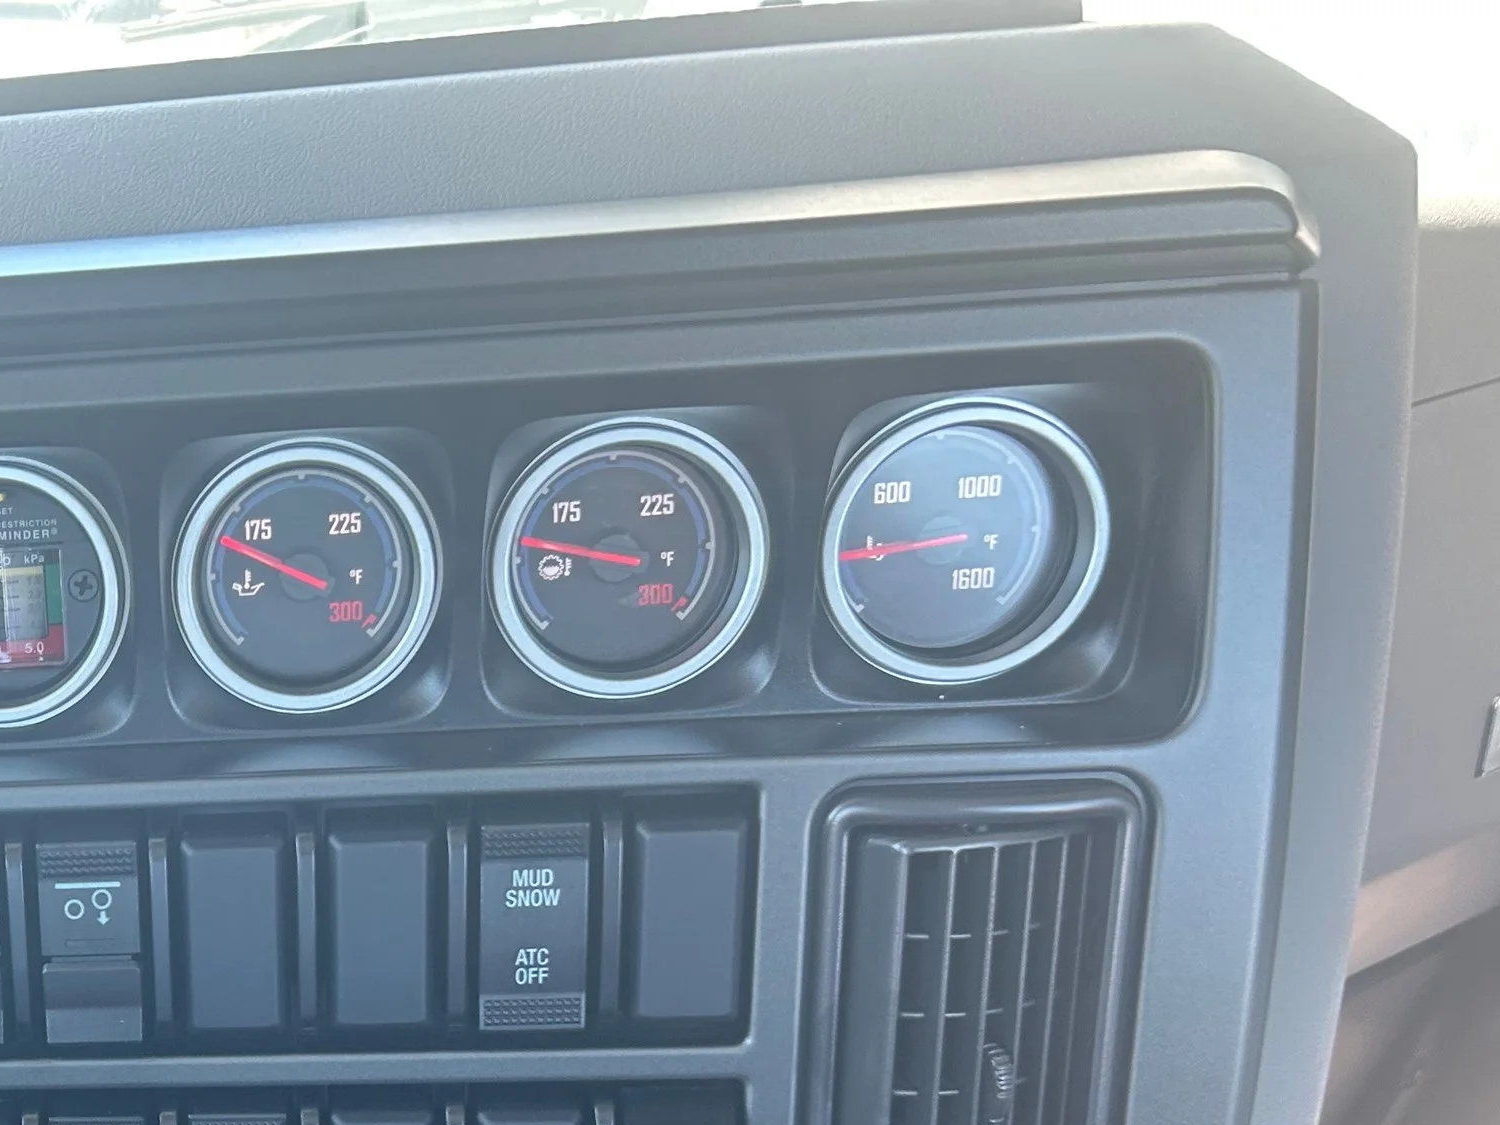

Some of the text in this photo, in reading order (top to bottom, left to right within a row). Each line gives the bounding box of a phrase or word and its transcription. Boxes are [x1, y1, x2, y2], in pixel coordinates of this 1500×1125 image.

[874, 481, 911, 504] 600
[958, 475, 1002, 499] 1000
[552, 500, 582, 523] 175
[640, 493, 675, 517] 225
[244, 519, 272, 540] 175
[328, 513, 362, 535] 225
[24, 554, 45, 564] kPa
[952, 567, 995, 590] 1600
[638, 584, 674, 606] 300
[329, 601, 363, 623] 300
[512, 868, 554, 887] MUD
[505, 888, 561, 908] SNOW
[514, 948, 549, 966] ATC
[515, 967, 549, 985] OFF
